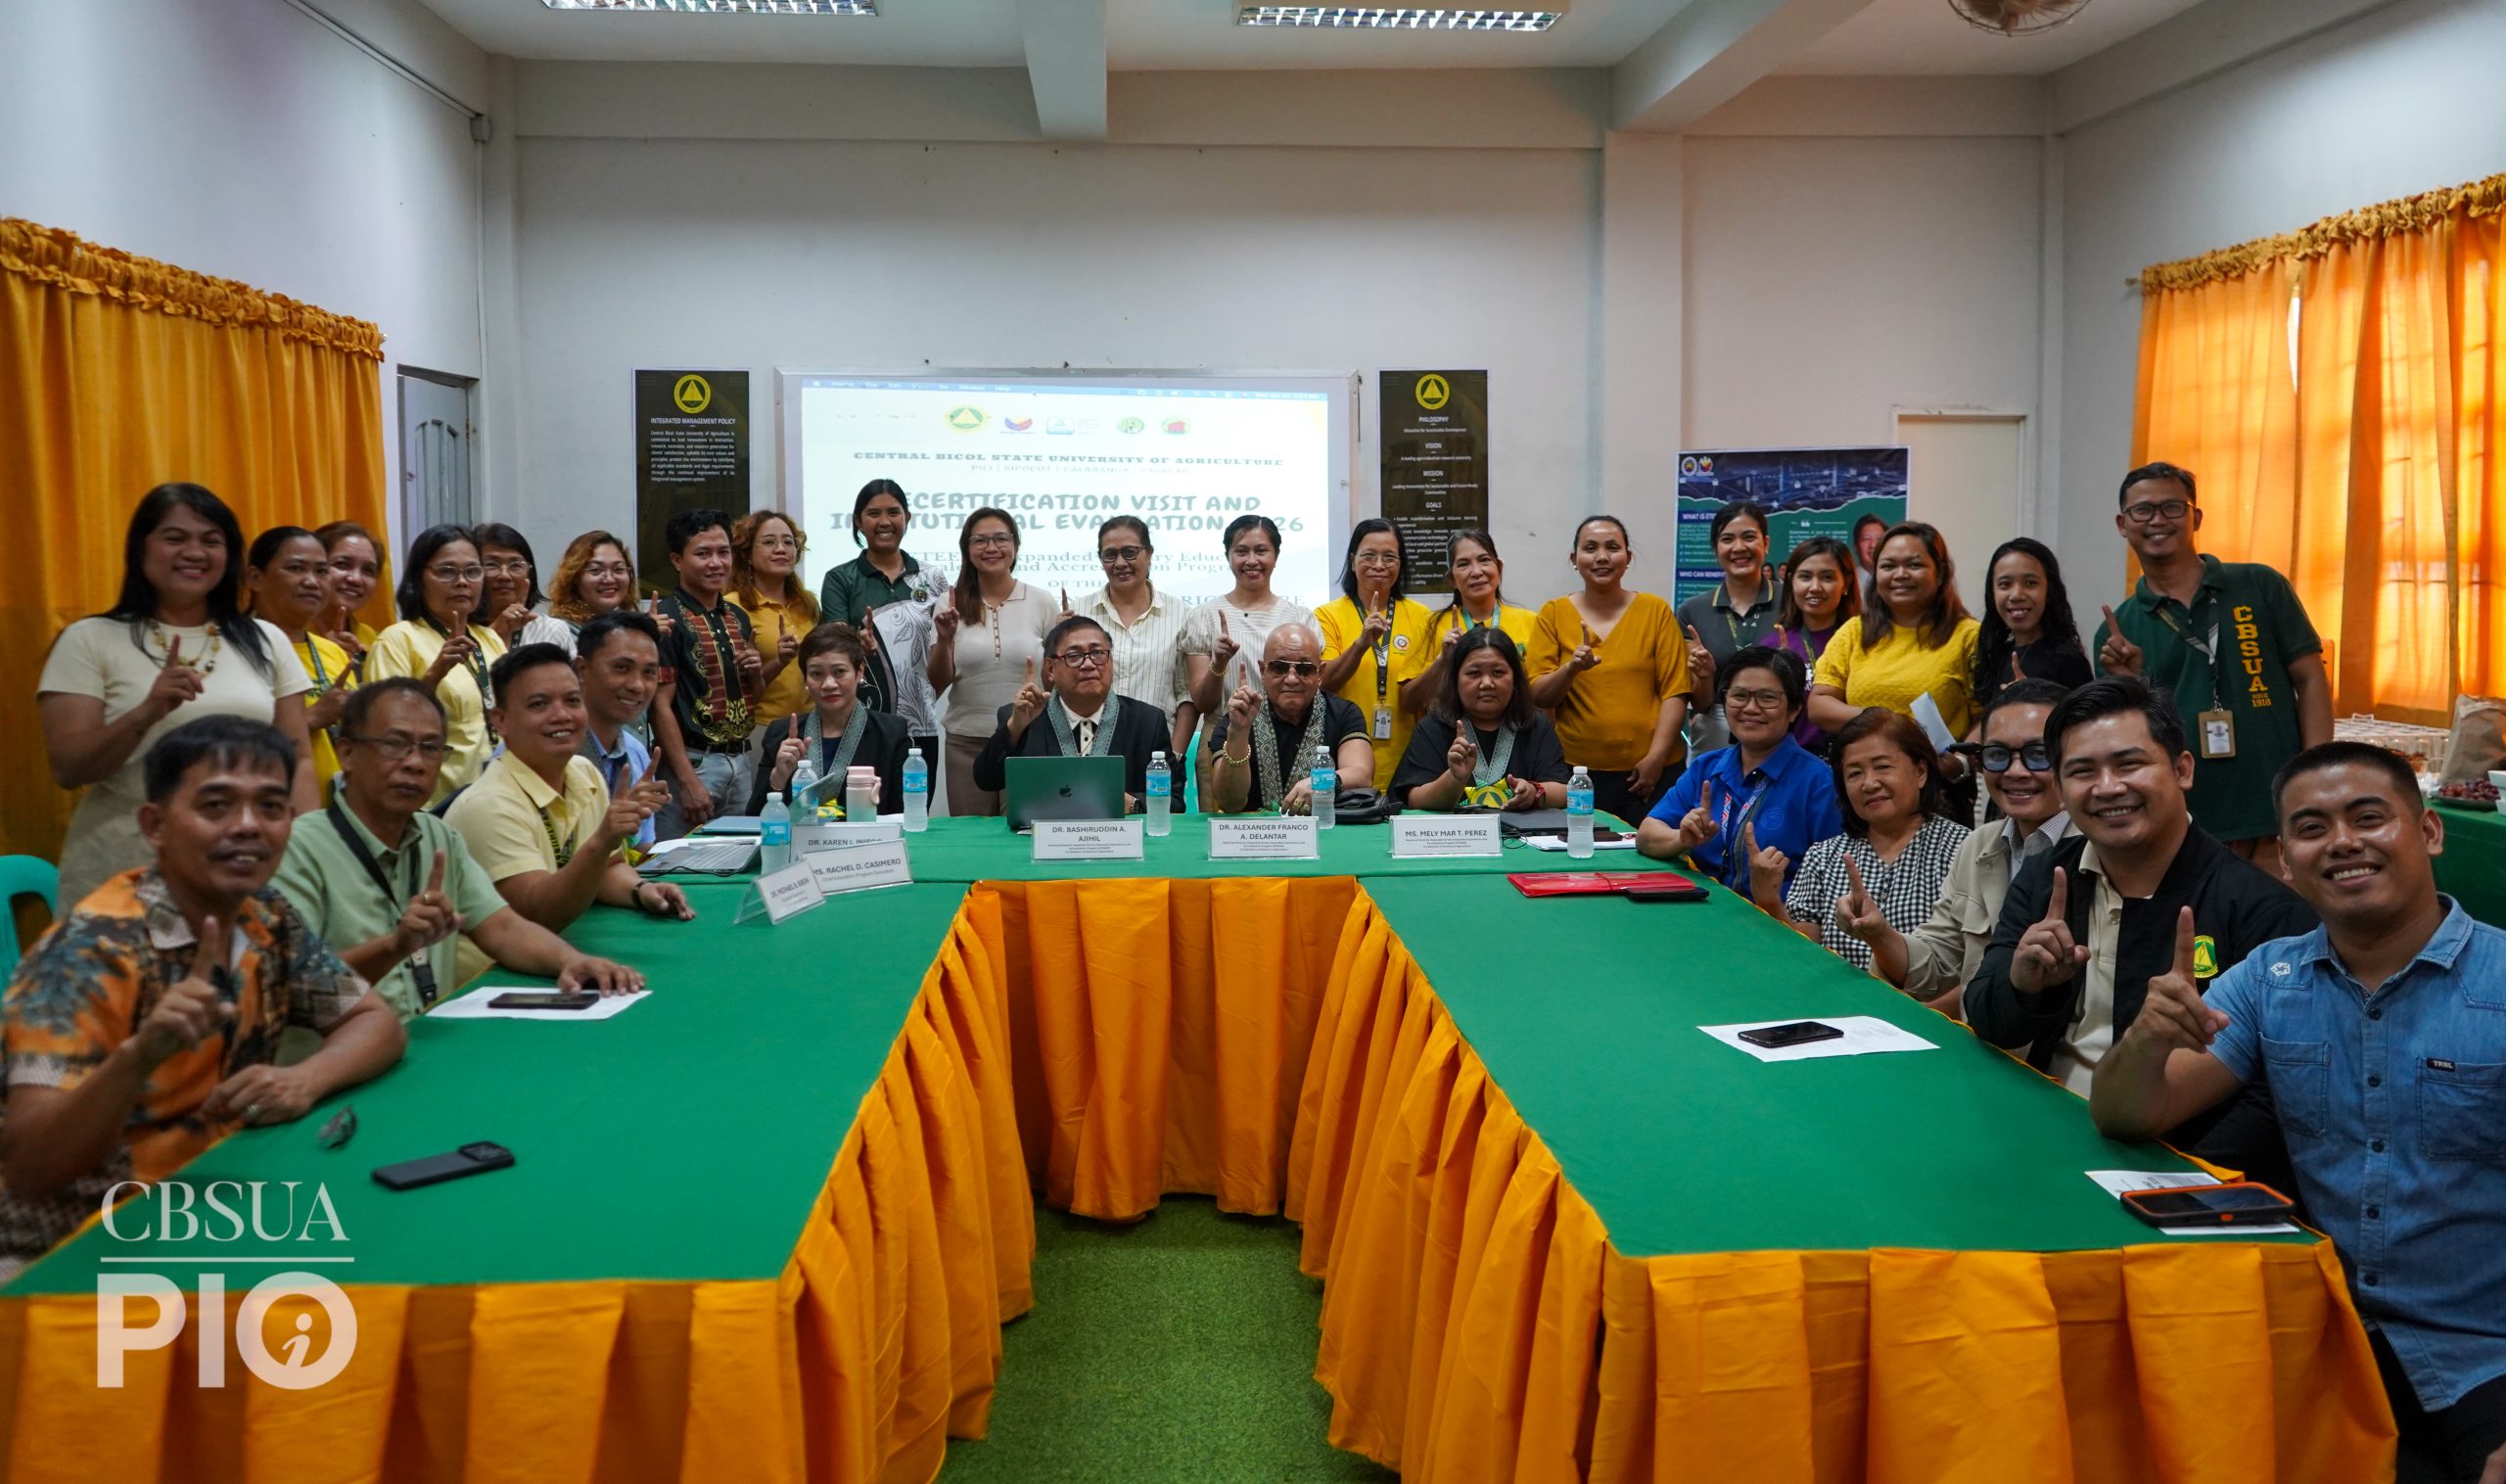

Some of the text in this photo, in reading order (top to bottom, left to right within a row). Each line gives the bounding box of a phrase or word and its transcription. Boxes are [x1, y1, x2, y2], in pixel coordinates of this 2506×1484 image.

[854, 451, 930, 460] CENTRAL
[936, 452, 987, 461] BICOL
[1048, 454, 1143, 463] UNIVERSITY
[1131, 495, 1196, 511] VISIT
[1205, 496, 1261, 511] AND
[1055, 514, 1224, 531] EVAATION
[2232, 605, 2269, 692] CBSUA
[826, 864, 855, 874] RACHEL
[864, 858, 902, 869] CASIMERO
